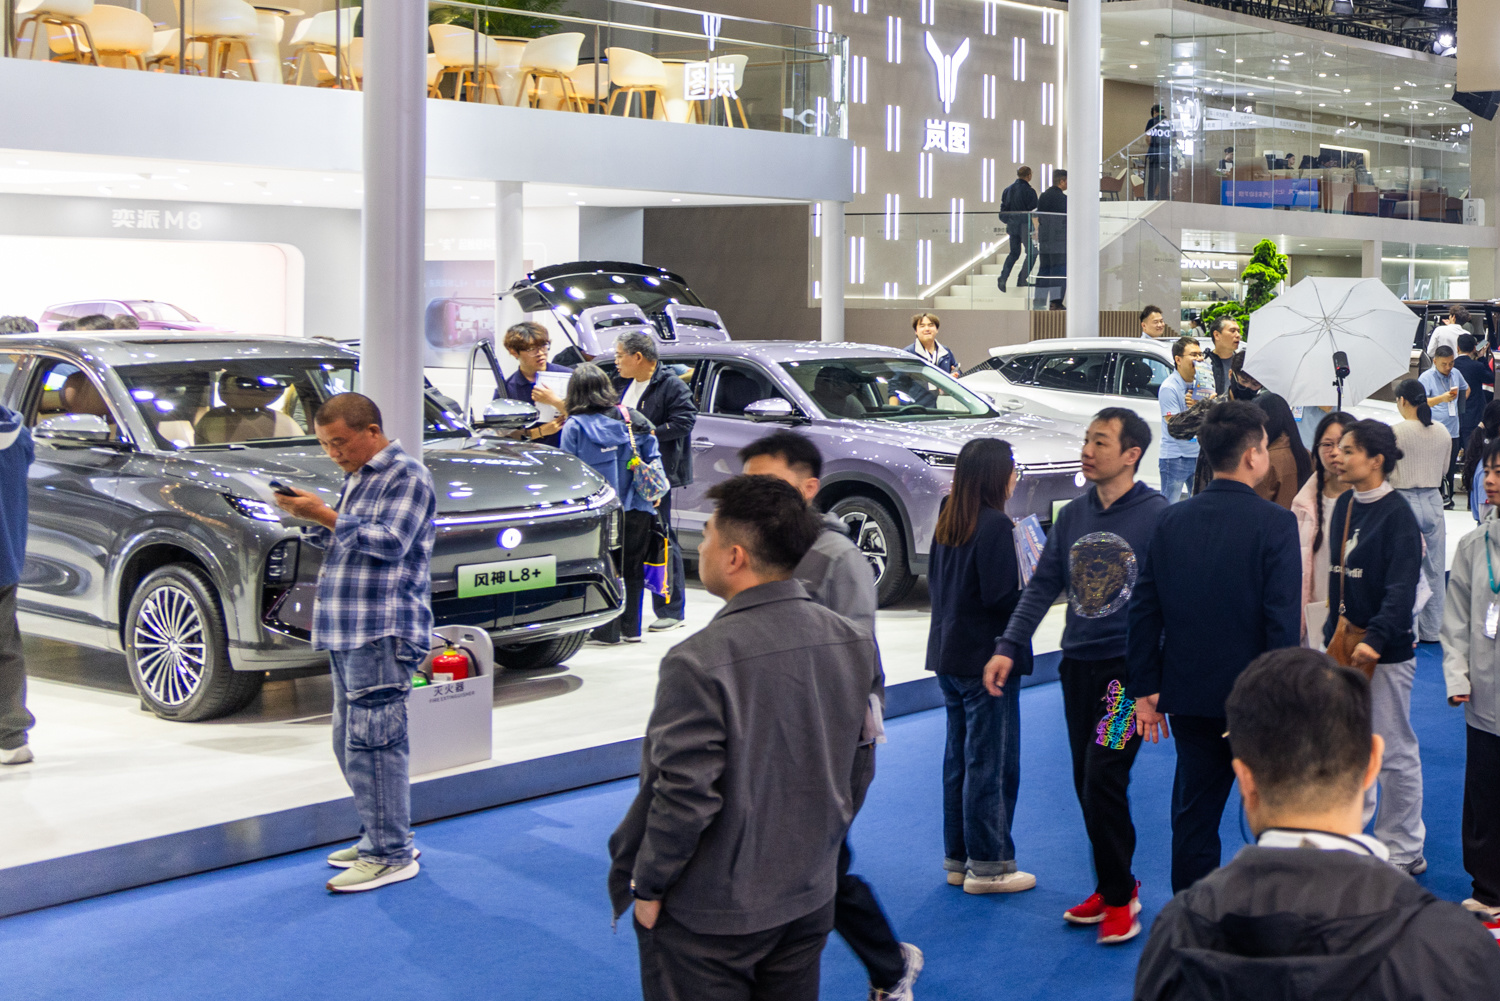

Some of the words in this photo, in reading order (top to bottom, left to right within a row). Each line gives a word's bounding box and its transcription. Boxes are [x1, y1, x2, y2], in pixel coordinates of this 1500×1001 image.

[922, 118, 970, 154] 岚图
[1180, 259, 1211, 269] OYAH
[1212, 260, 1237, 270] LIFE
[433, 682, 464, 697] 灭火器
